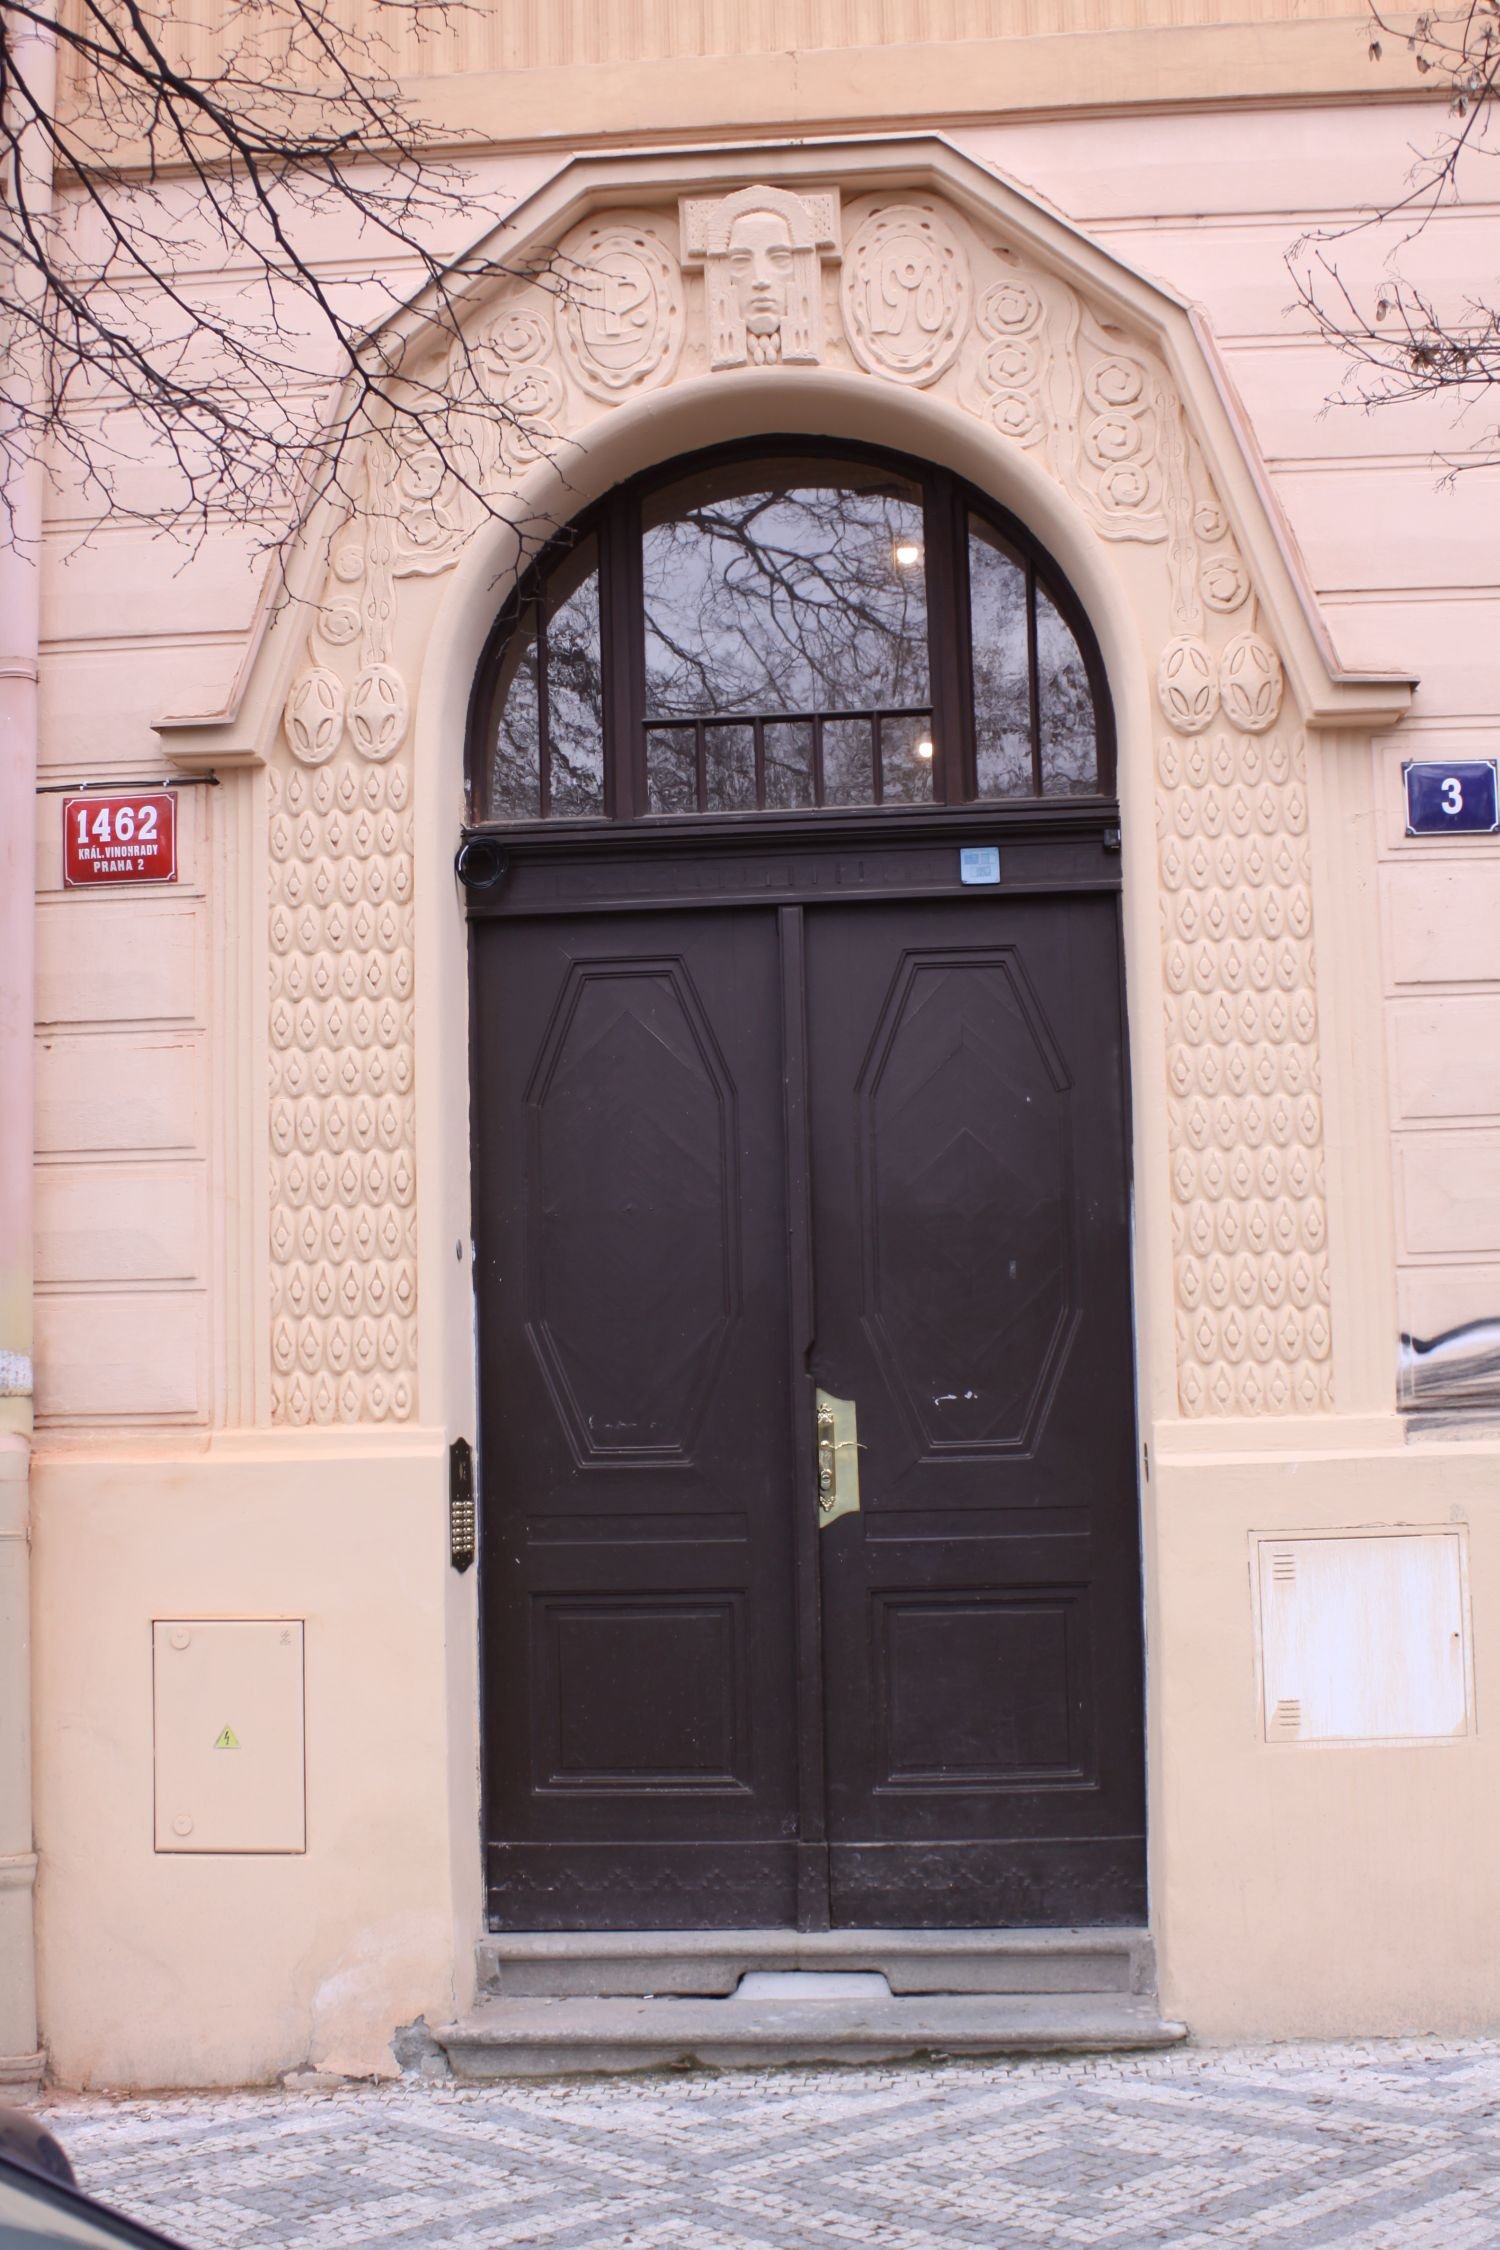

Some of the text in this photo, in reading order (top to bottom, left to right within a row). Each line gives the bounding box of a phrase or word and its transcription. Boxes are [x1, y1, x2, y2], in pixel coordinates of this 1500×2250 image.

[1441, 777, 1463, 815] 3
[77, 805, 158, 844] 1462
[94, 859, 144, 872] PRAHA 2
